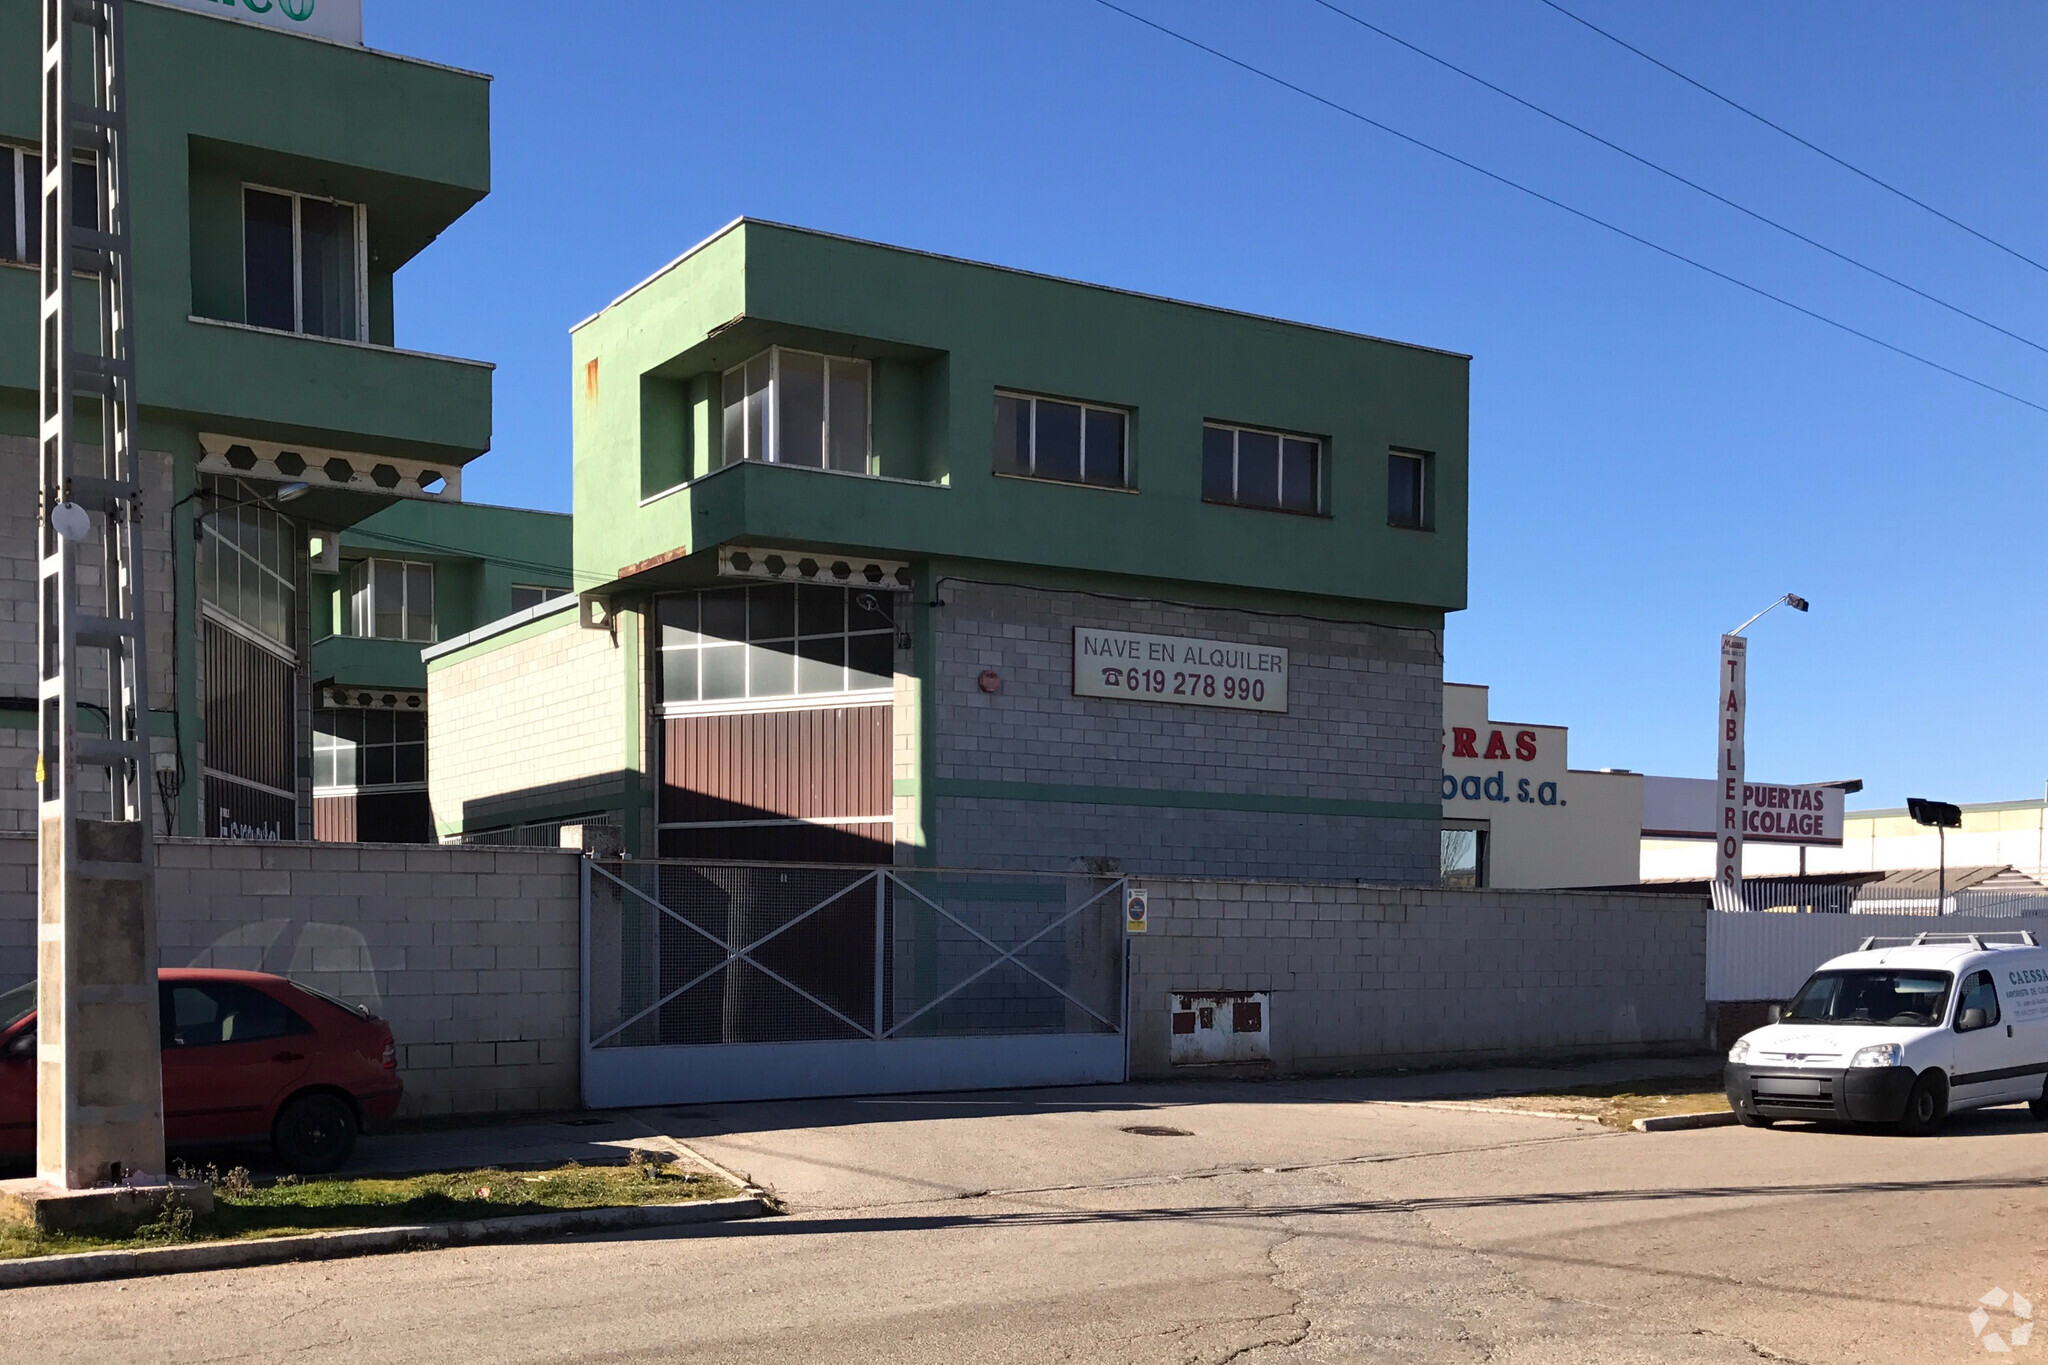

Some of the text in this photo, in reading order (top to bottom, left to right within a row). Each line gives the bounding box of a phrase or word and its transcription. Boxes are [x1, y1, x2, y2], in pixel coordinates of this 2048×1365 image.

[1083, 635, 1282, 673] NAVE EN ALQUILER
[1126, 667, 1265, 702] 619 278 990
[1723, 659, 1739, 888] TABLEROS
[1743, 784, 1824, 812] PUERTAS
